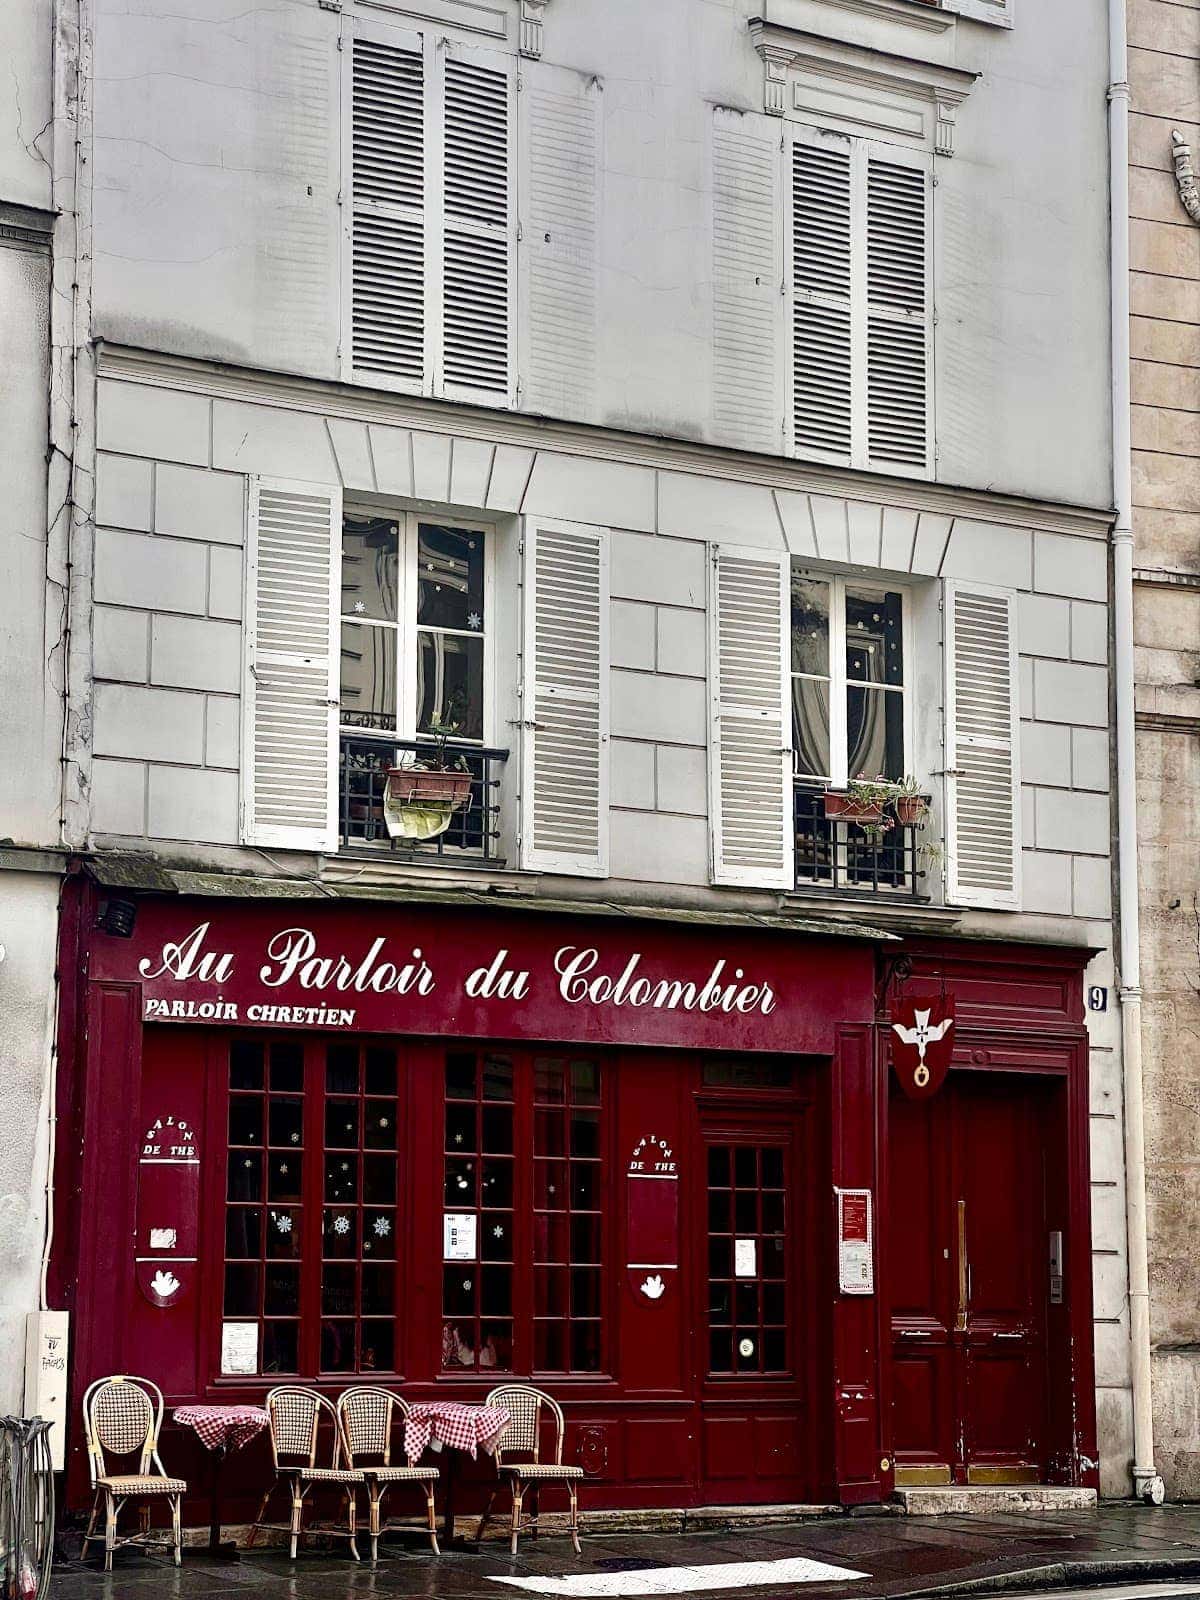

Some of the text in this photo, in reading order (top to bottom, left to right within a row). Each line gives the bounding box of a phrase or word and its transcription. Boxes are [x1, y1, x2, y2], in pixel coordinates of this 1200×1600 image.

[138, 921, 777, 1014] Au Parloir du Colombier
[1092, 988, 1104, 1010] 9
[146, 1116, 193, 1140] SALON
[143, 1145, 195, 1156] DE THE
[633, 1135, 672, 1158] SALON
[630, 1161, 676, 1171] DE THE
